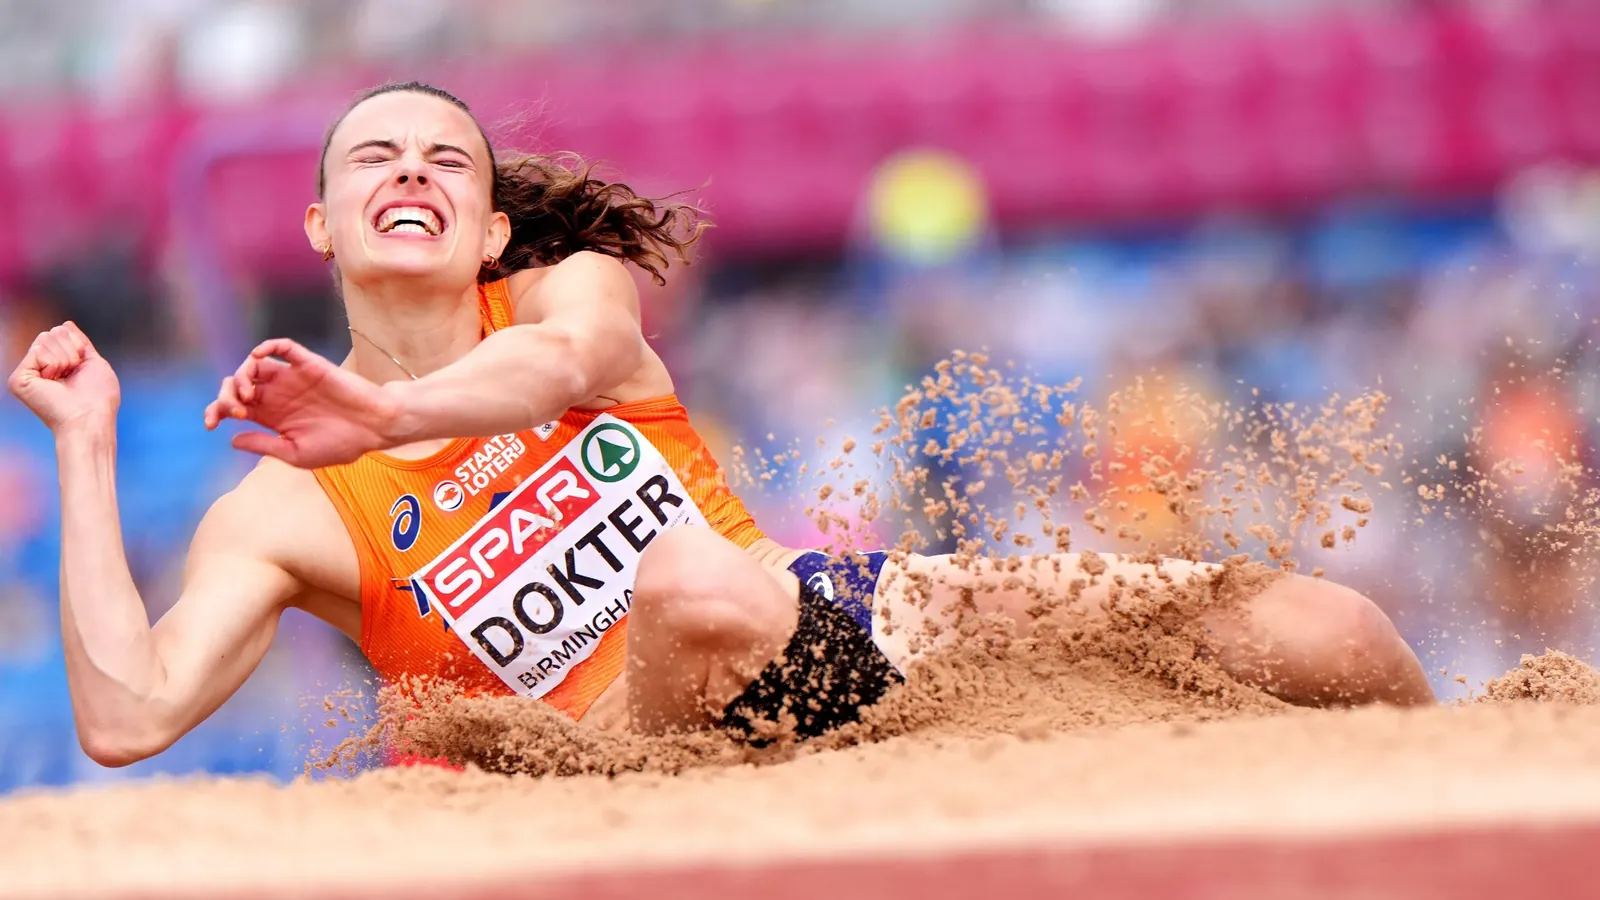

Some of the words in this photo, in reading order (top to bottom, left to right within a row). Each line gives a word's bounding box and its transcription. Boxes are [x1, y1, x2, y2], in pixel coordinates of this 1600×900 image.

[454, 433, 515, 482] STAATS
[464, 437, 526, 496] LOTERIJ
[434, 469, 590, 607] SPAR
[470, 474, 684, 668] DOKTER
